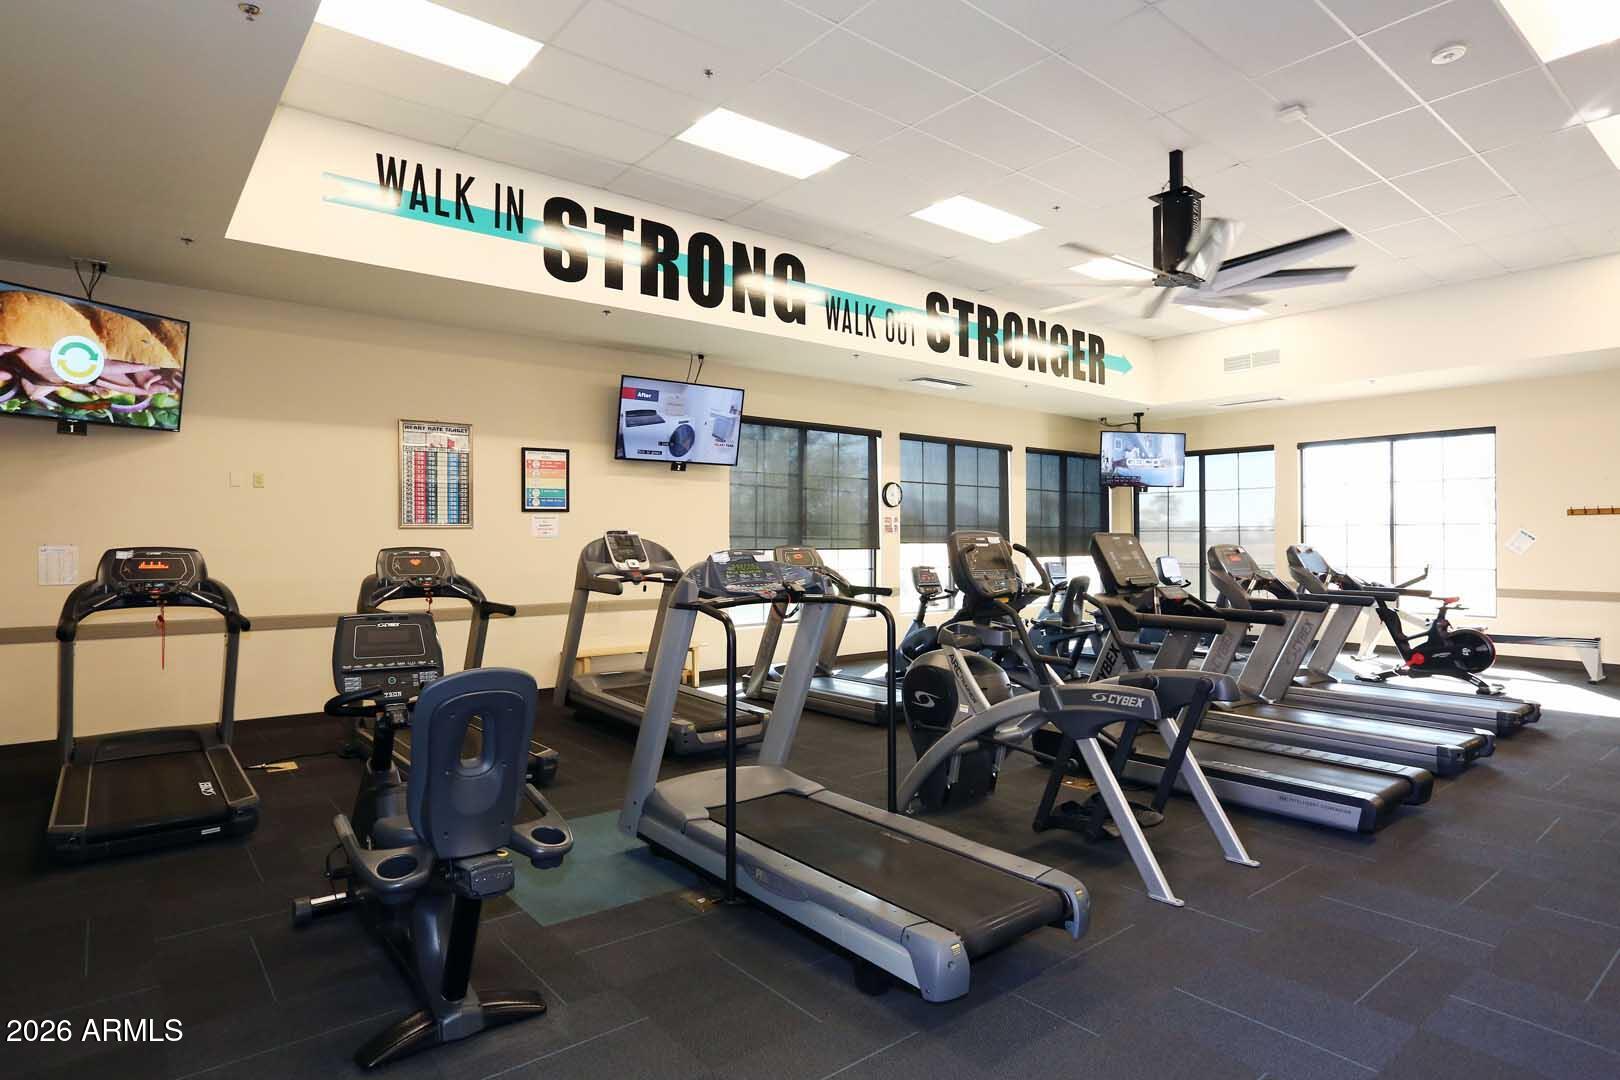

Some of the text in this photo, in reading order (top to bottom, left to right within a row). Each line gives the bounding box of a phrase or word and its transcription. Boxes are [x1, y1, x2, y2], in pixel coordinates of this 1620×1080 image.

[376, 153, 476, 224] WALK
[495, 183, 524, 234] IN
[543, 196, 807, 326] STRONG
[825, 294, 877, 339] WALK
[925, 291, 1106, 385] STRONGER
[637, 391, 652, 399] After
[1096, 643, 1120, 681] YBEX
[1107, 694, 1144, 708] CYBEX
